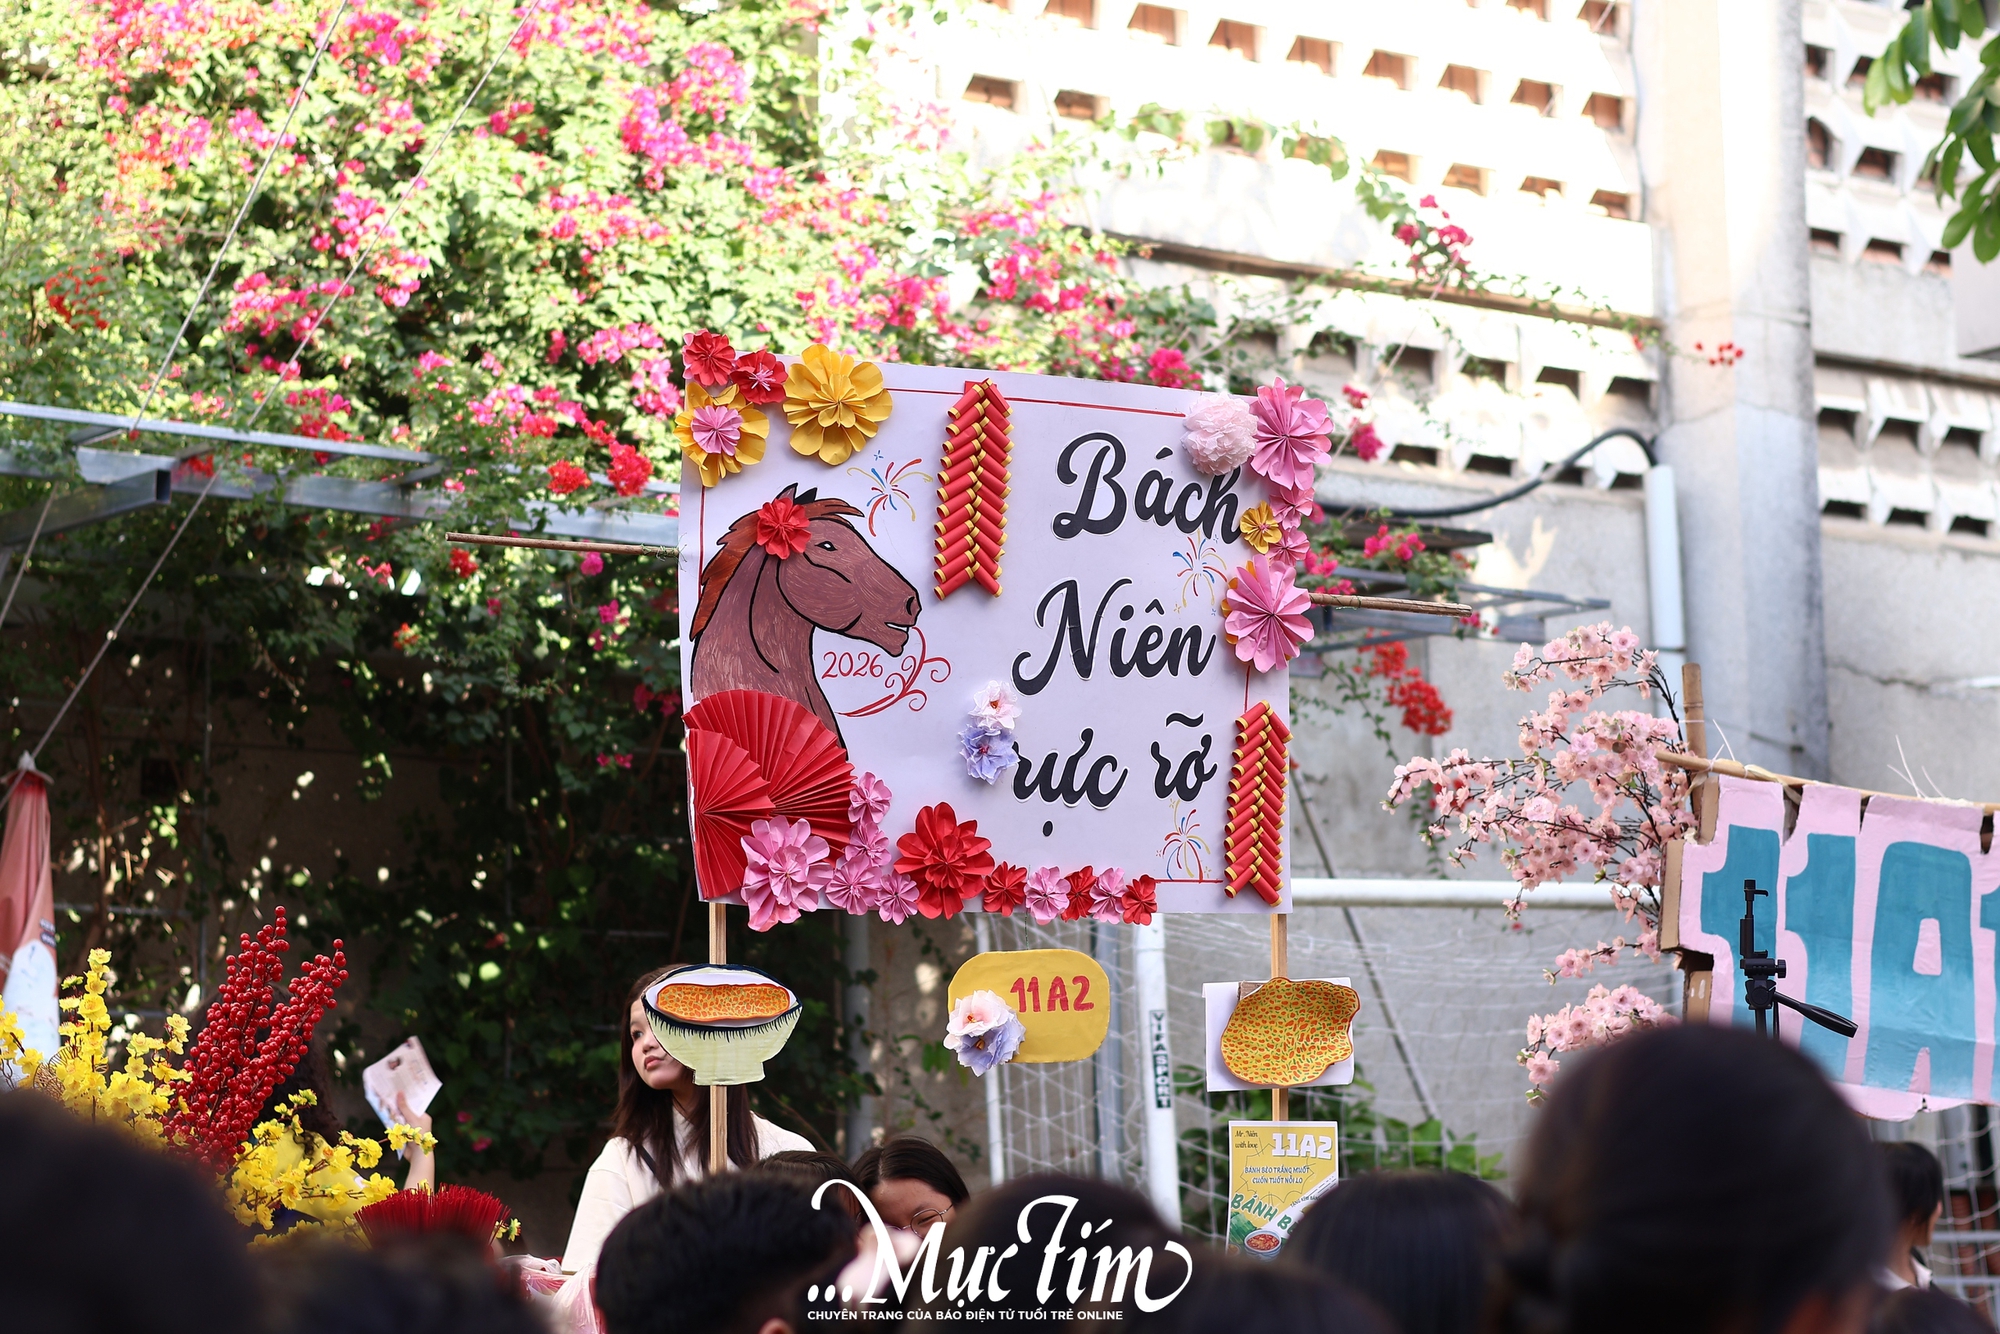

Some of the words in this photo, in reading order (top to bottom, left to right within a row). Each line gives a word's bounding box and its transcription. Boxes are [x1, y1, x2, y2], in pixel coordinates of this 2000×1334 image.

[1052, 431, 1241, 544] Bách
[1011, 577, 1217, 696] Niên
[821, 651, 884, 679] 2026
[1011, 727, 1129, 837] rực
[1150, 711, 1218, 802] rỡ
[1010, 975, 1095, 1013] 11A2
[1234, 1141, 1247, 1149] with
[1247, 1141, 1259, 1149] love
[1271, 1132, 1333, 1160] 11A2
[1230, 1193, 1279, 1222] BÁNH
